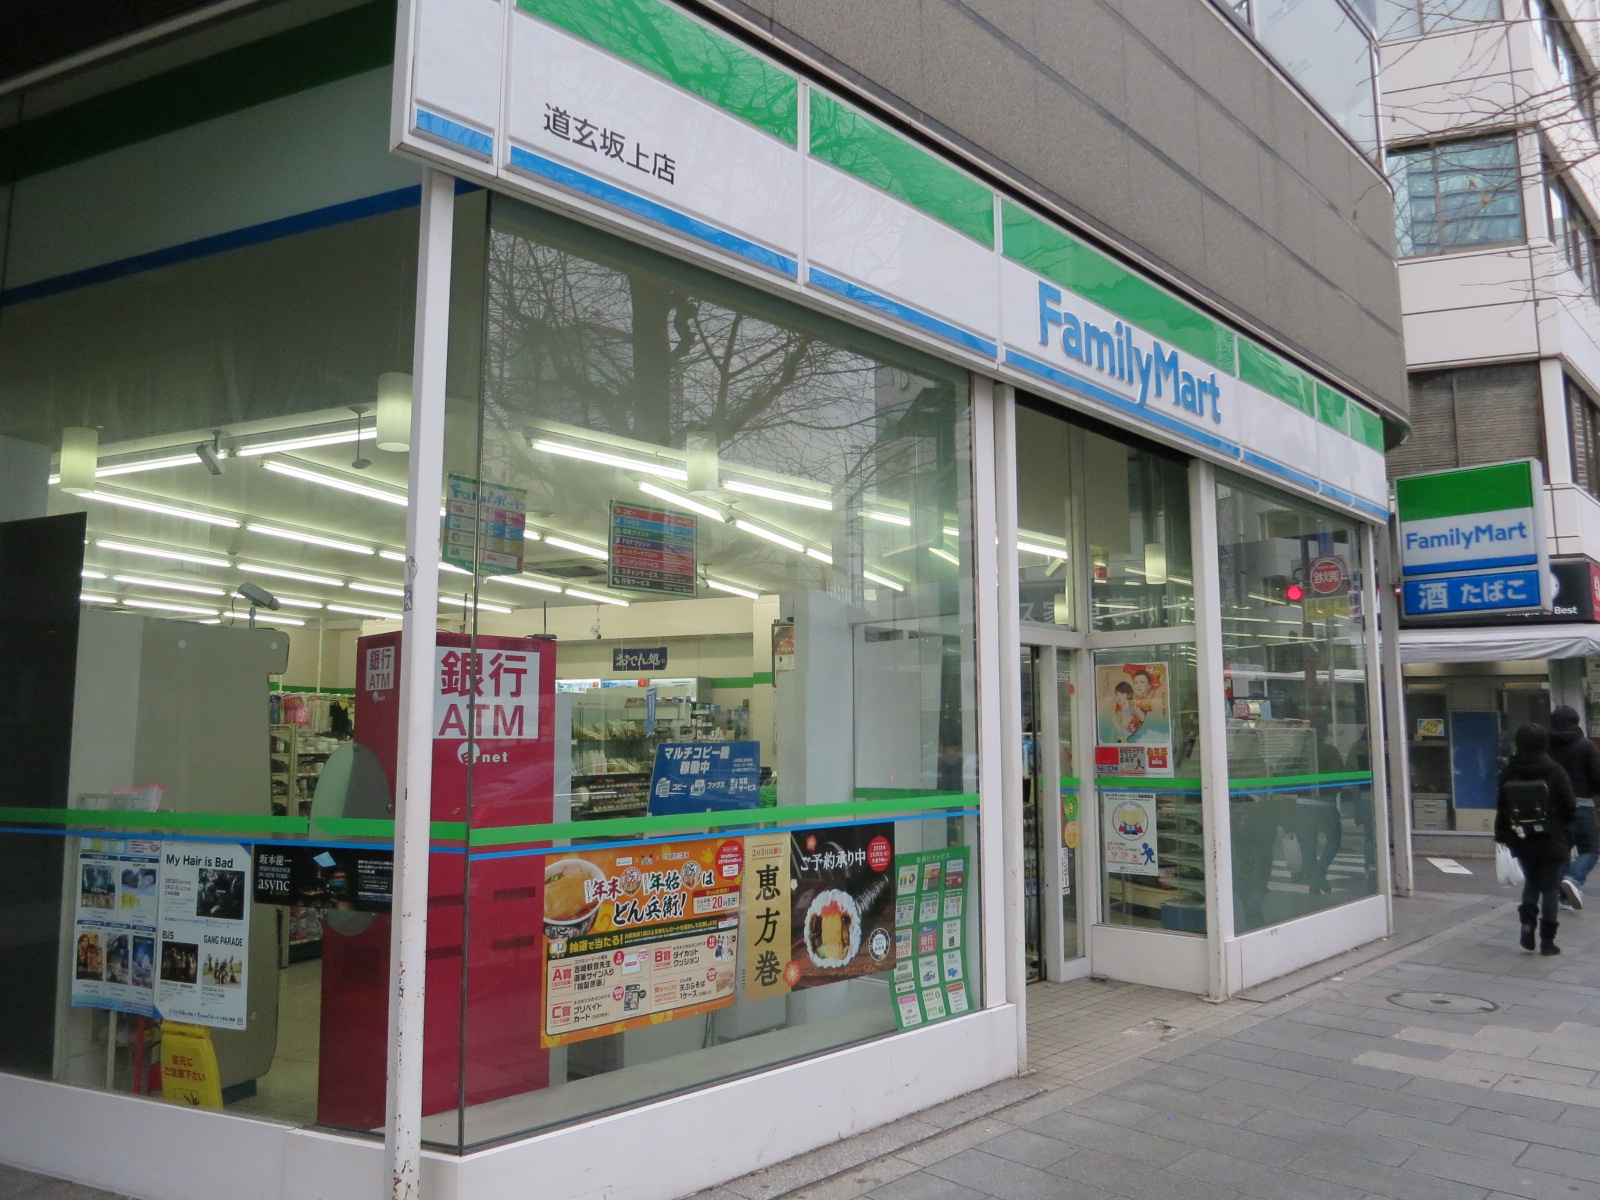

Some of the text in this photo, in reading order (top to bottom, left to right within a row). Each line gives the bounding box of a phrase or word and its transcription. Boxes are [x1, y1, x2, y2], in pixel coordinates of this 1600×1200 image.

[544, 102, 676, 185] 道玄坂上店
[1037, 280, 1222, 424] FamilyMart
[1406, 521, 1527, 550] FamilyMart
[1418, 580, 1527, 610] 酒 たばこ
[1553, 606, 1578, 615] Best
[369, 648, 391, 671] 銀行
[369, 673, 390, 689] ATM
[440, 650, 528, 698] 銀行
[438, 703, 525, 737] ATM
[672, 783, 687, 791] コピー
[166, 854, 234, 868] My Hair is Bad
[800, 848, 866, 871] ご予約承り中
[258, 879, 290, 894] async
[592, 877, 623, 899] 年末
[650, 871, 682, 892] 年始
[702, 871, 714, 886] は
[162, 931, 175, 940] BiS
[754, 864, 782, 987] 恵方巻
[203, 935, 243, 947] GANG PARADE
[172, 1055, 194, 1067] 足元に
[164, 1067, 206, 1082] ご注意下さい
